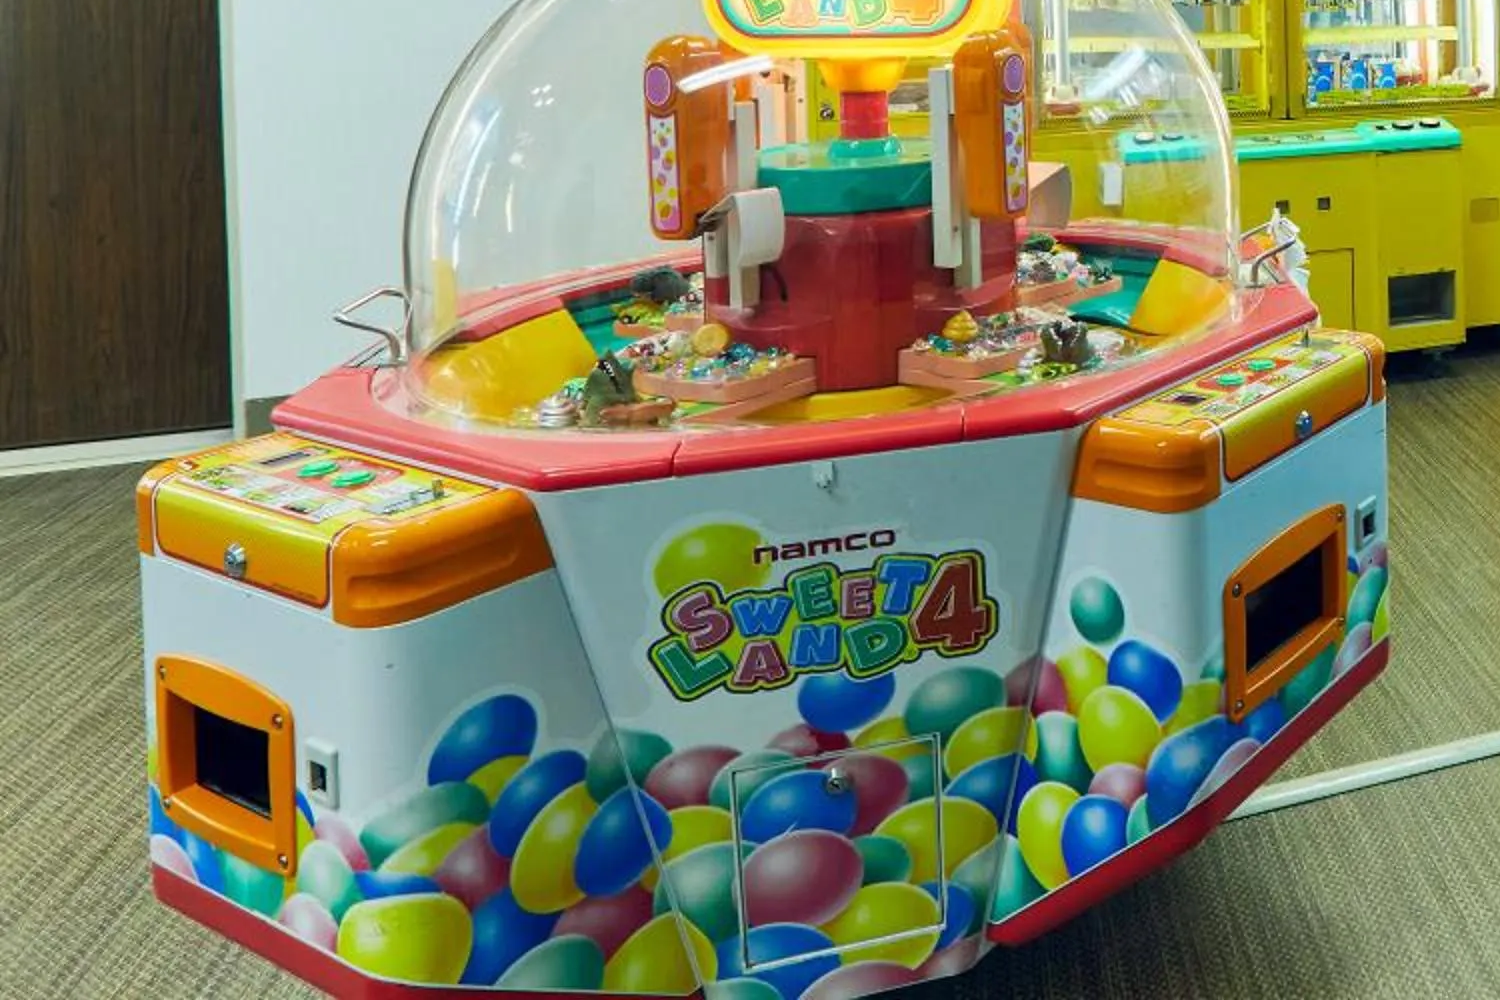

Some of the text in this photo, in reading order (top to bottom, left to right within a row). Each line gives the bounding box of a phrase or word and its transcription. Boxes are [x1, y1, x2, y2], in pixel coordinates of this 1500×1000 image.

[752, 528, 896, 565] namco
[670, 555, 992, 654] SWEET 4
[652, 616, 907, 696] LAND
